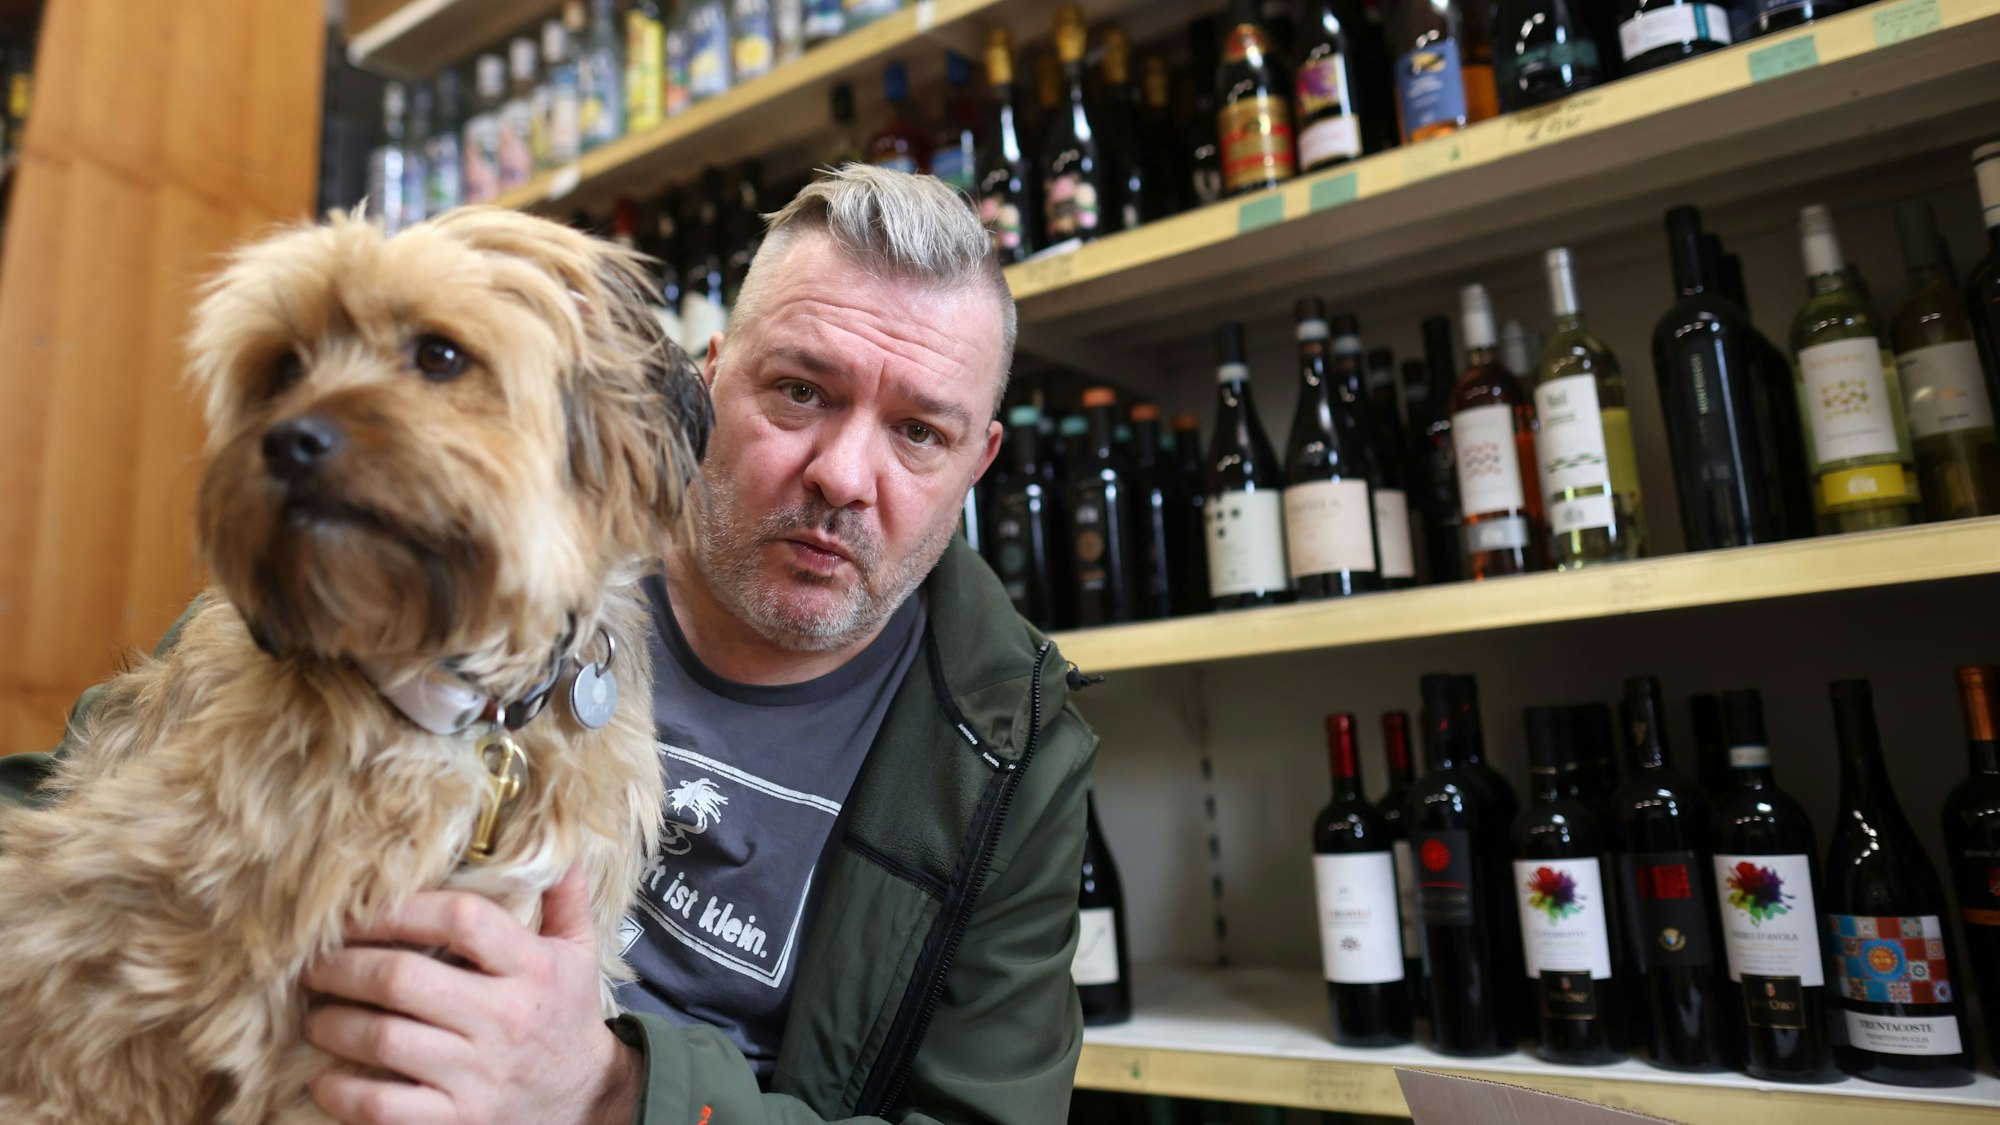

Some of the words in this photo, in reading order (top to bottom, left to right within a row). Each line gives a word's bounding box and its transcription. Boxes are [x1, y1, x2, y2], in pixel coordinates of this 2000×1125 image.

[662, 871, 699, 919] ist
[698, 895, 767, 958] klein.
[1858, 1019, 1935, 1034] TRENTACOSTE
